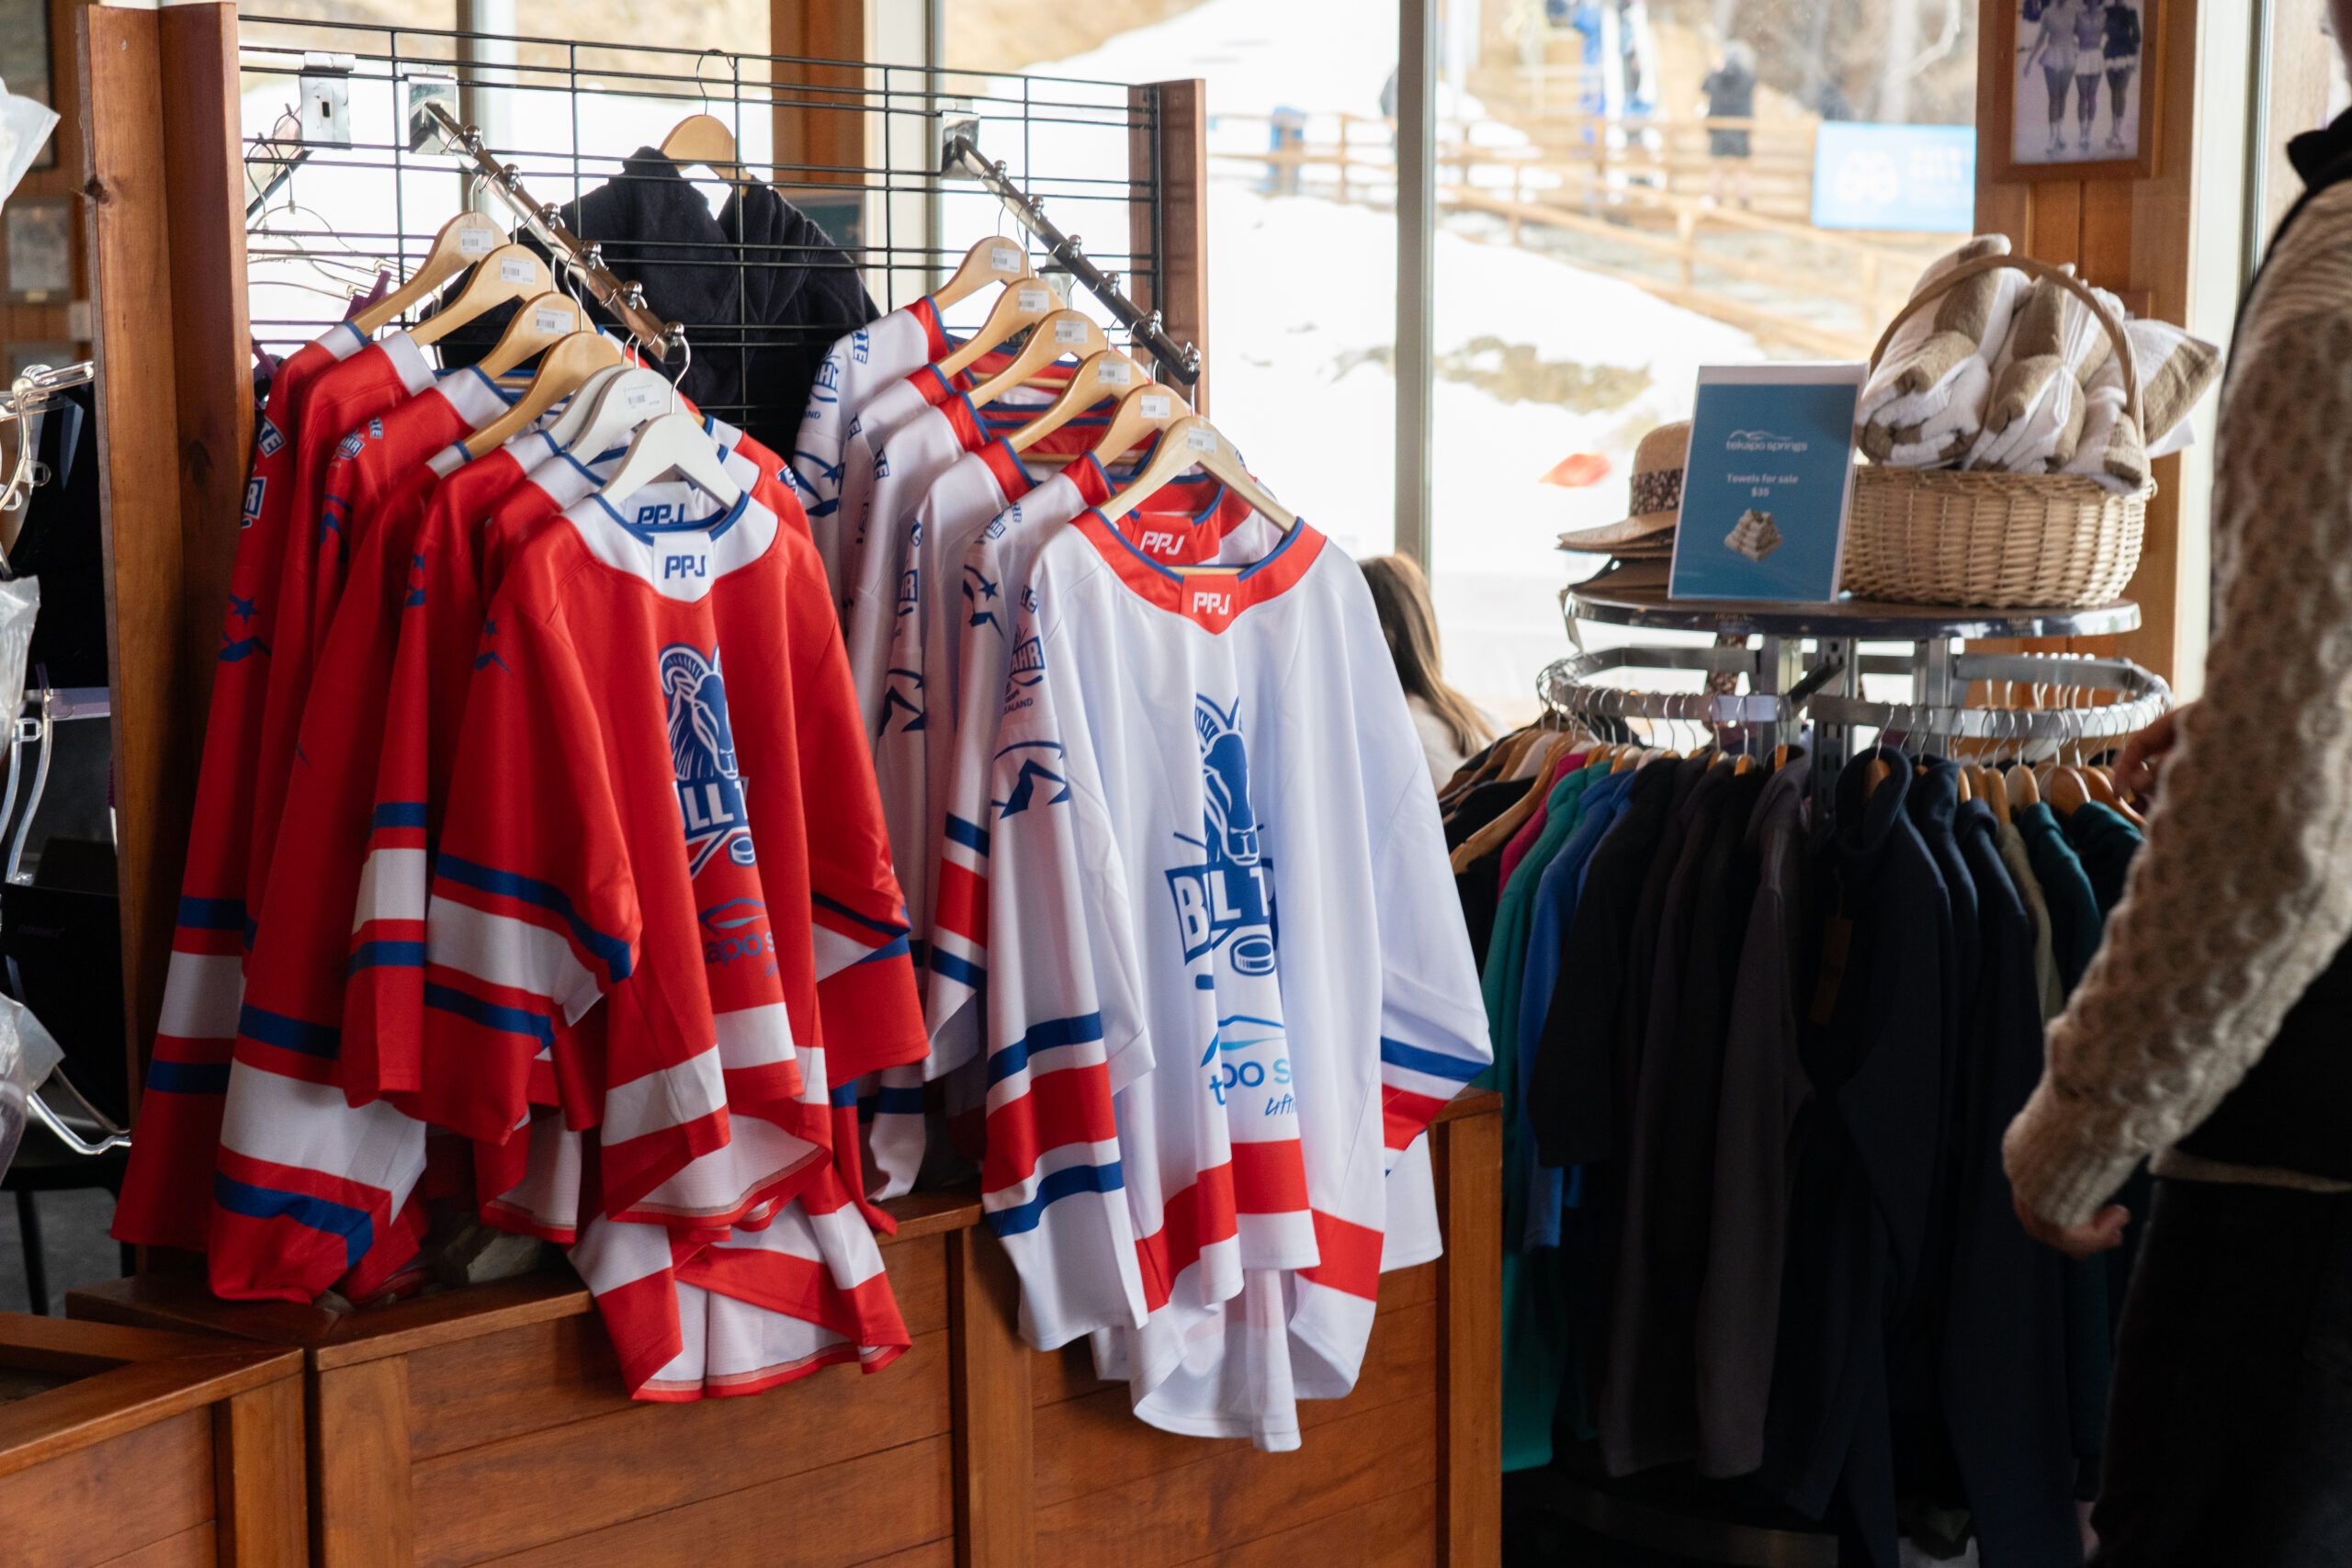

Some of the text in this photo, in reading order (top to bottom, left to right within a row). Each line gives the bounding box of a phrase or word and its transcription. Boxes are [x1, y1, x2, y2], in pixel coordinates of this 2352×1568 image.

[1725, 440, 1808, 452] tekapo springs
[1726, 473, 1799, 484] Towels for sale
[637, 503, 685, 525] PPJ
[1138, 530, 1185, 556] PPJ
[663, 555, 706, 579] PPJ
[1193, 592, 1231, 615] PPJ
[1012, 641, 1043, 673] AHR
